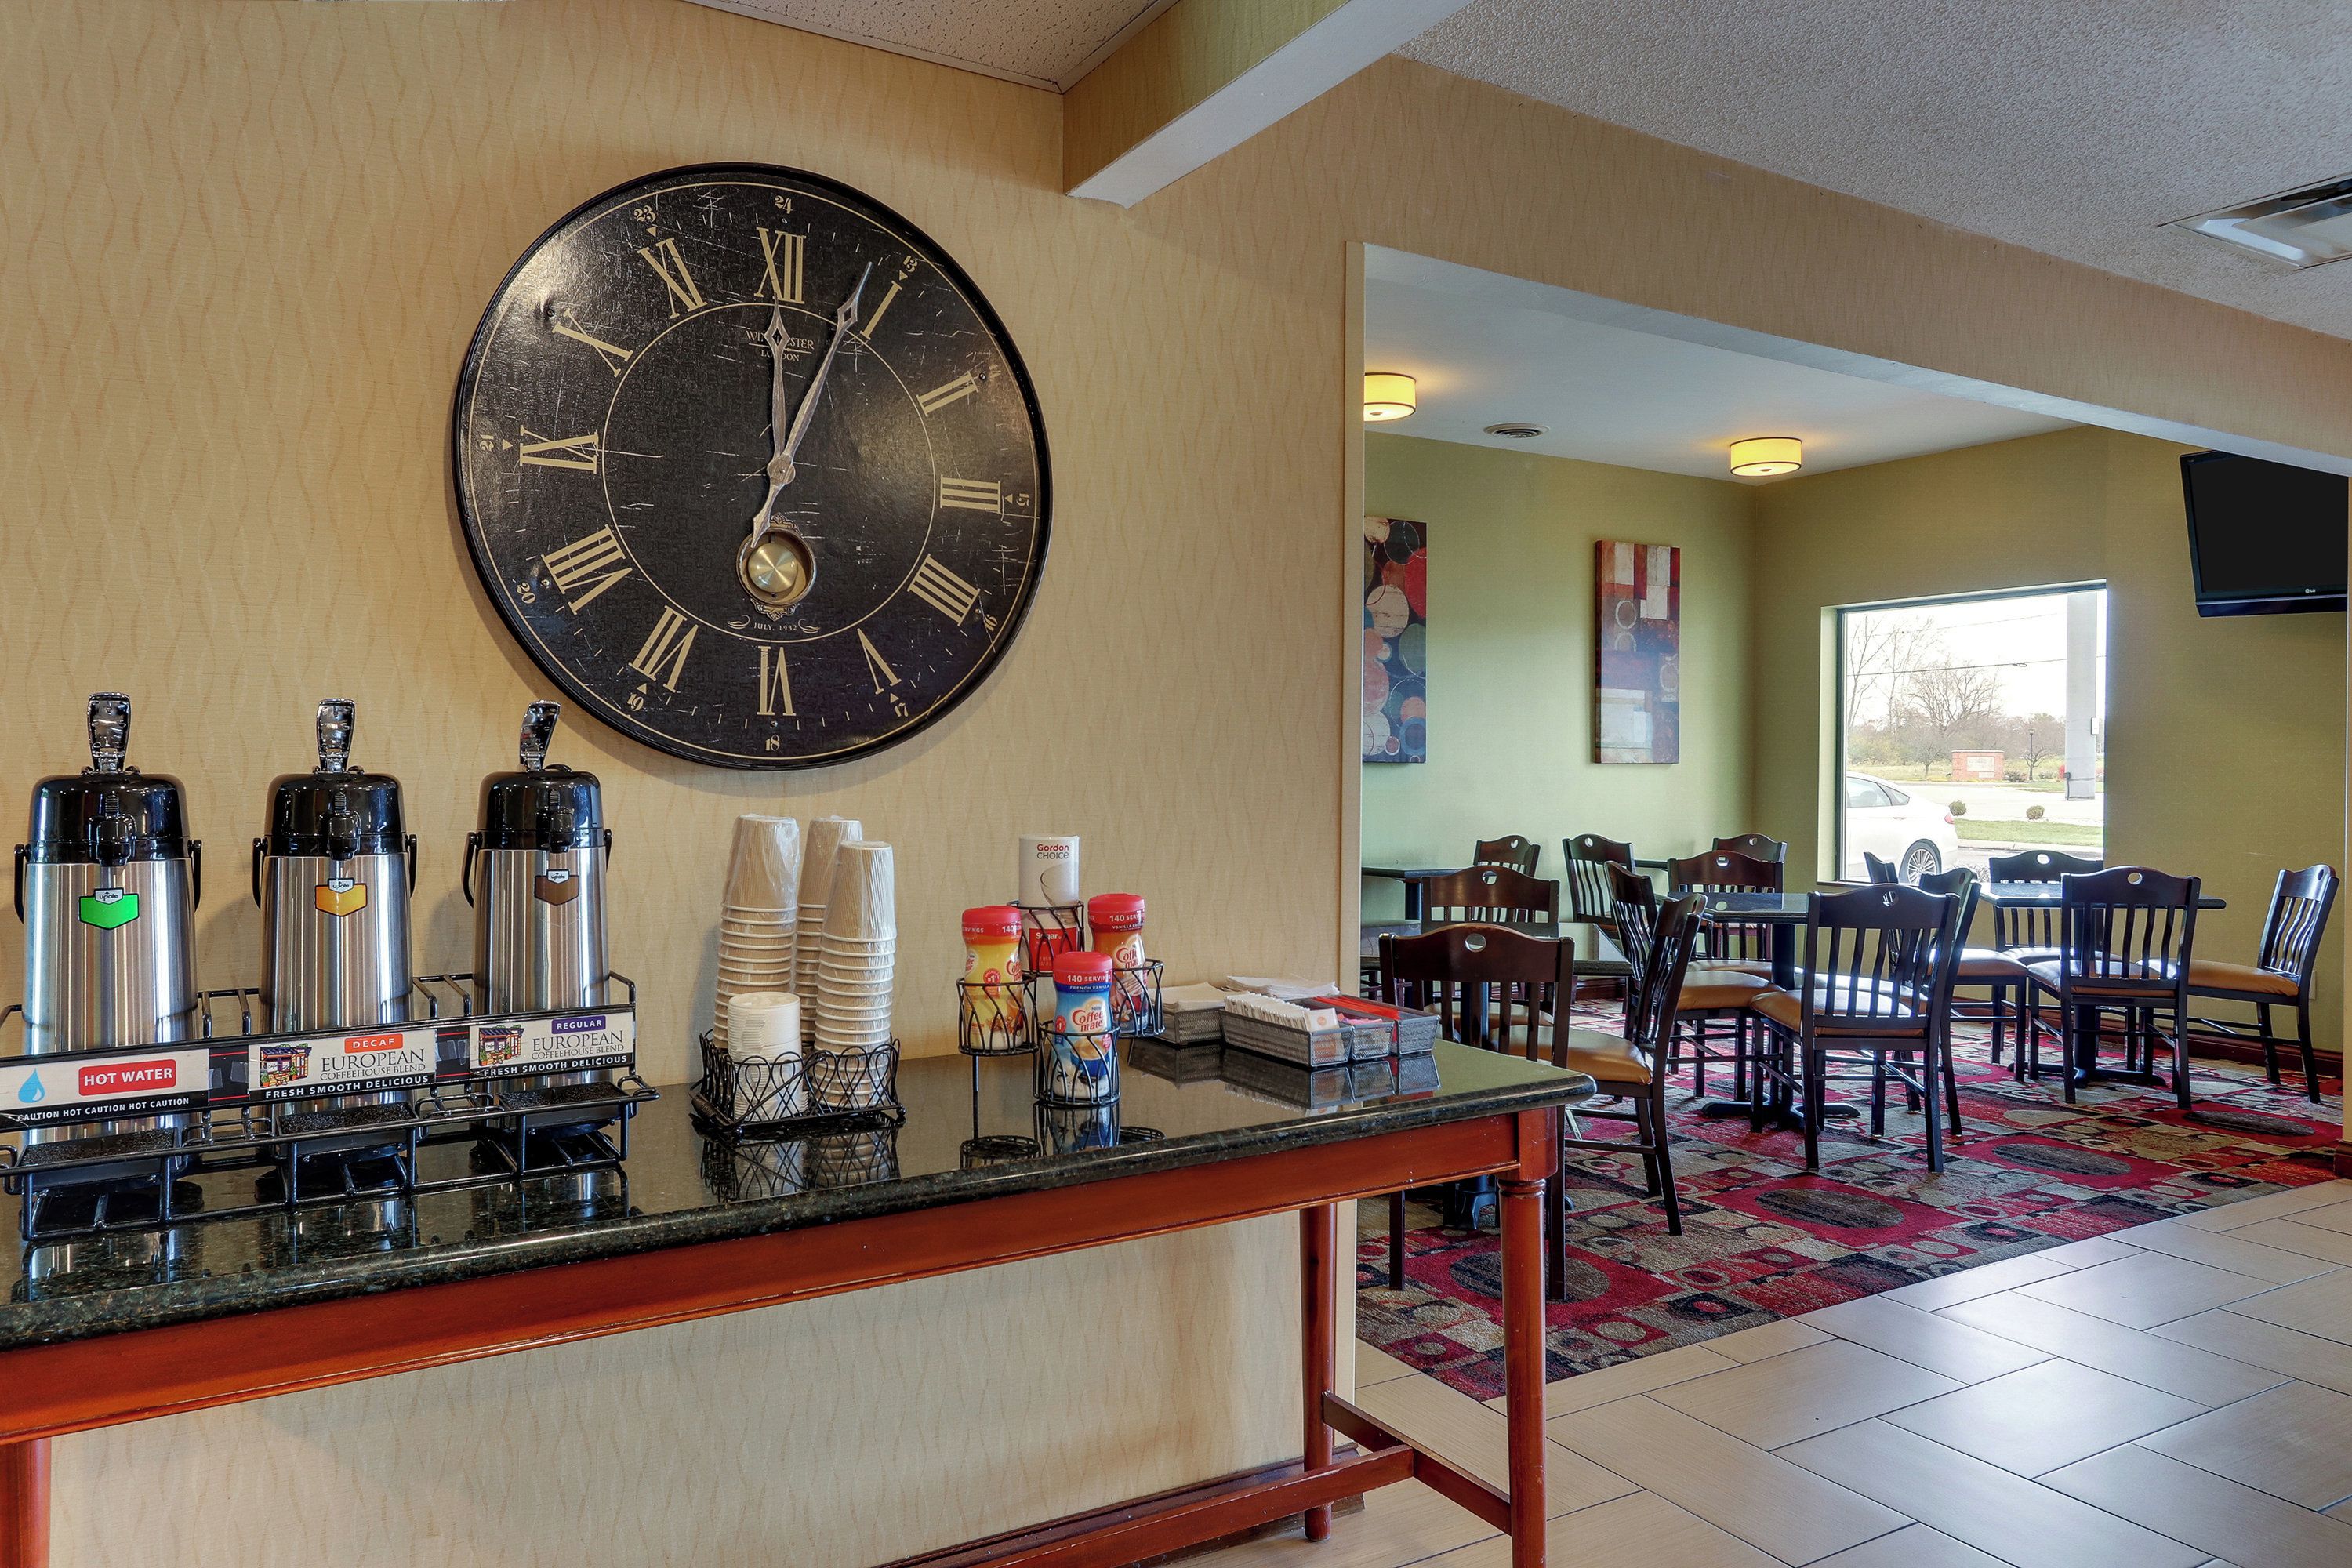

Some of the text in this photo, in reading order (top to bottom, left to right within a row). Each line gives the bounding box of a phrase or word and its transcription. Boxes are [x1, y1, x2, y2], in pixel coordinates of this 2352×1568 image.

[633, 205, 657, 223] 23
[775, 195, 793, 214] 24
[754, 227, 807, 304] XII
[637, 237, 708, 319] XI
[551, 307, 633, 378] X
[916, 370, 979, 417] II
[519, 425, 599, 474] IX
[940, 474, 1000, 514] III
[540, 524, 633, 615] VIII
[516, 582, 536, 604] 20
[907, 553, 981, 626] IIII
[628, 604, 699, 693] VII
[857, 628, 902, 695] V
[757, 645, 797, 717] VI
[627, 693, 644, 711] 19
[894, 702, 909, 717] 17
[765, 734, 781, 752] 18
[556, 1019, 602, 1030] REGULAR
[1080, 1020, 1102, 1033] mate
[352, 1037, 395, 1049] DECAF
[531, 1044, 624, 1060] COFFEEHOUSE BLEND
[532, 1030, 623, 1051] EUROPEAN
[321, 1048, 425, 1072] EUROPEAN
[484, 1055, 627, 1076] FRESH SMOOTH DELICIOUS
[84, 1067, 172, 1087] HOT WATER
[320, 1063, 426, 1081] COFFEEHOUSE BLEND
[265, 1075, 429, 1099] FRESH SMOOTH DELICIOUS
[17, 1098, 189, 1122] CAUTION HOT CAUTION HOT CAUTION
